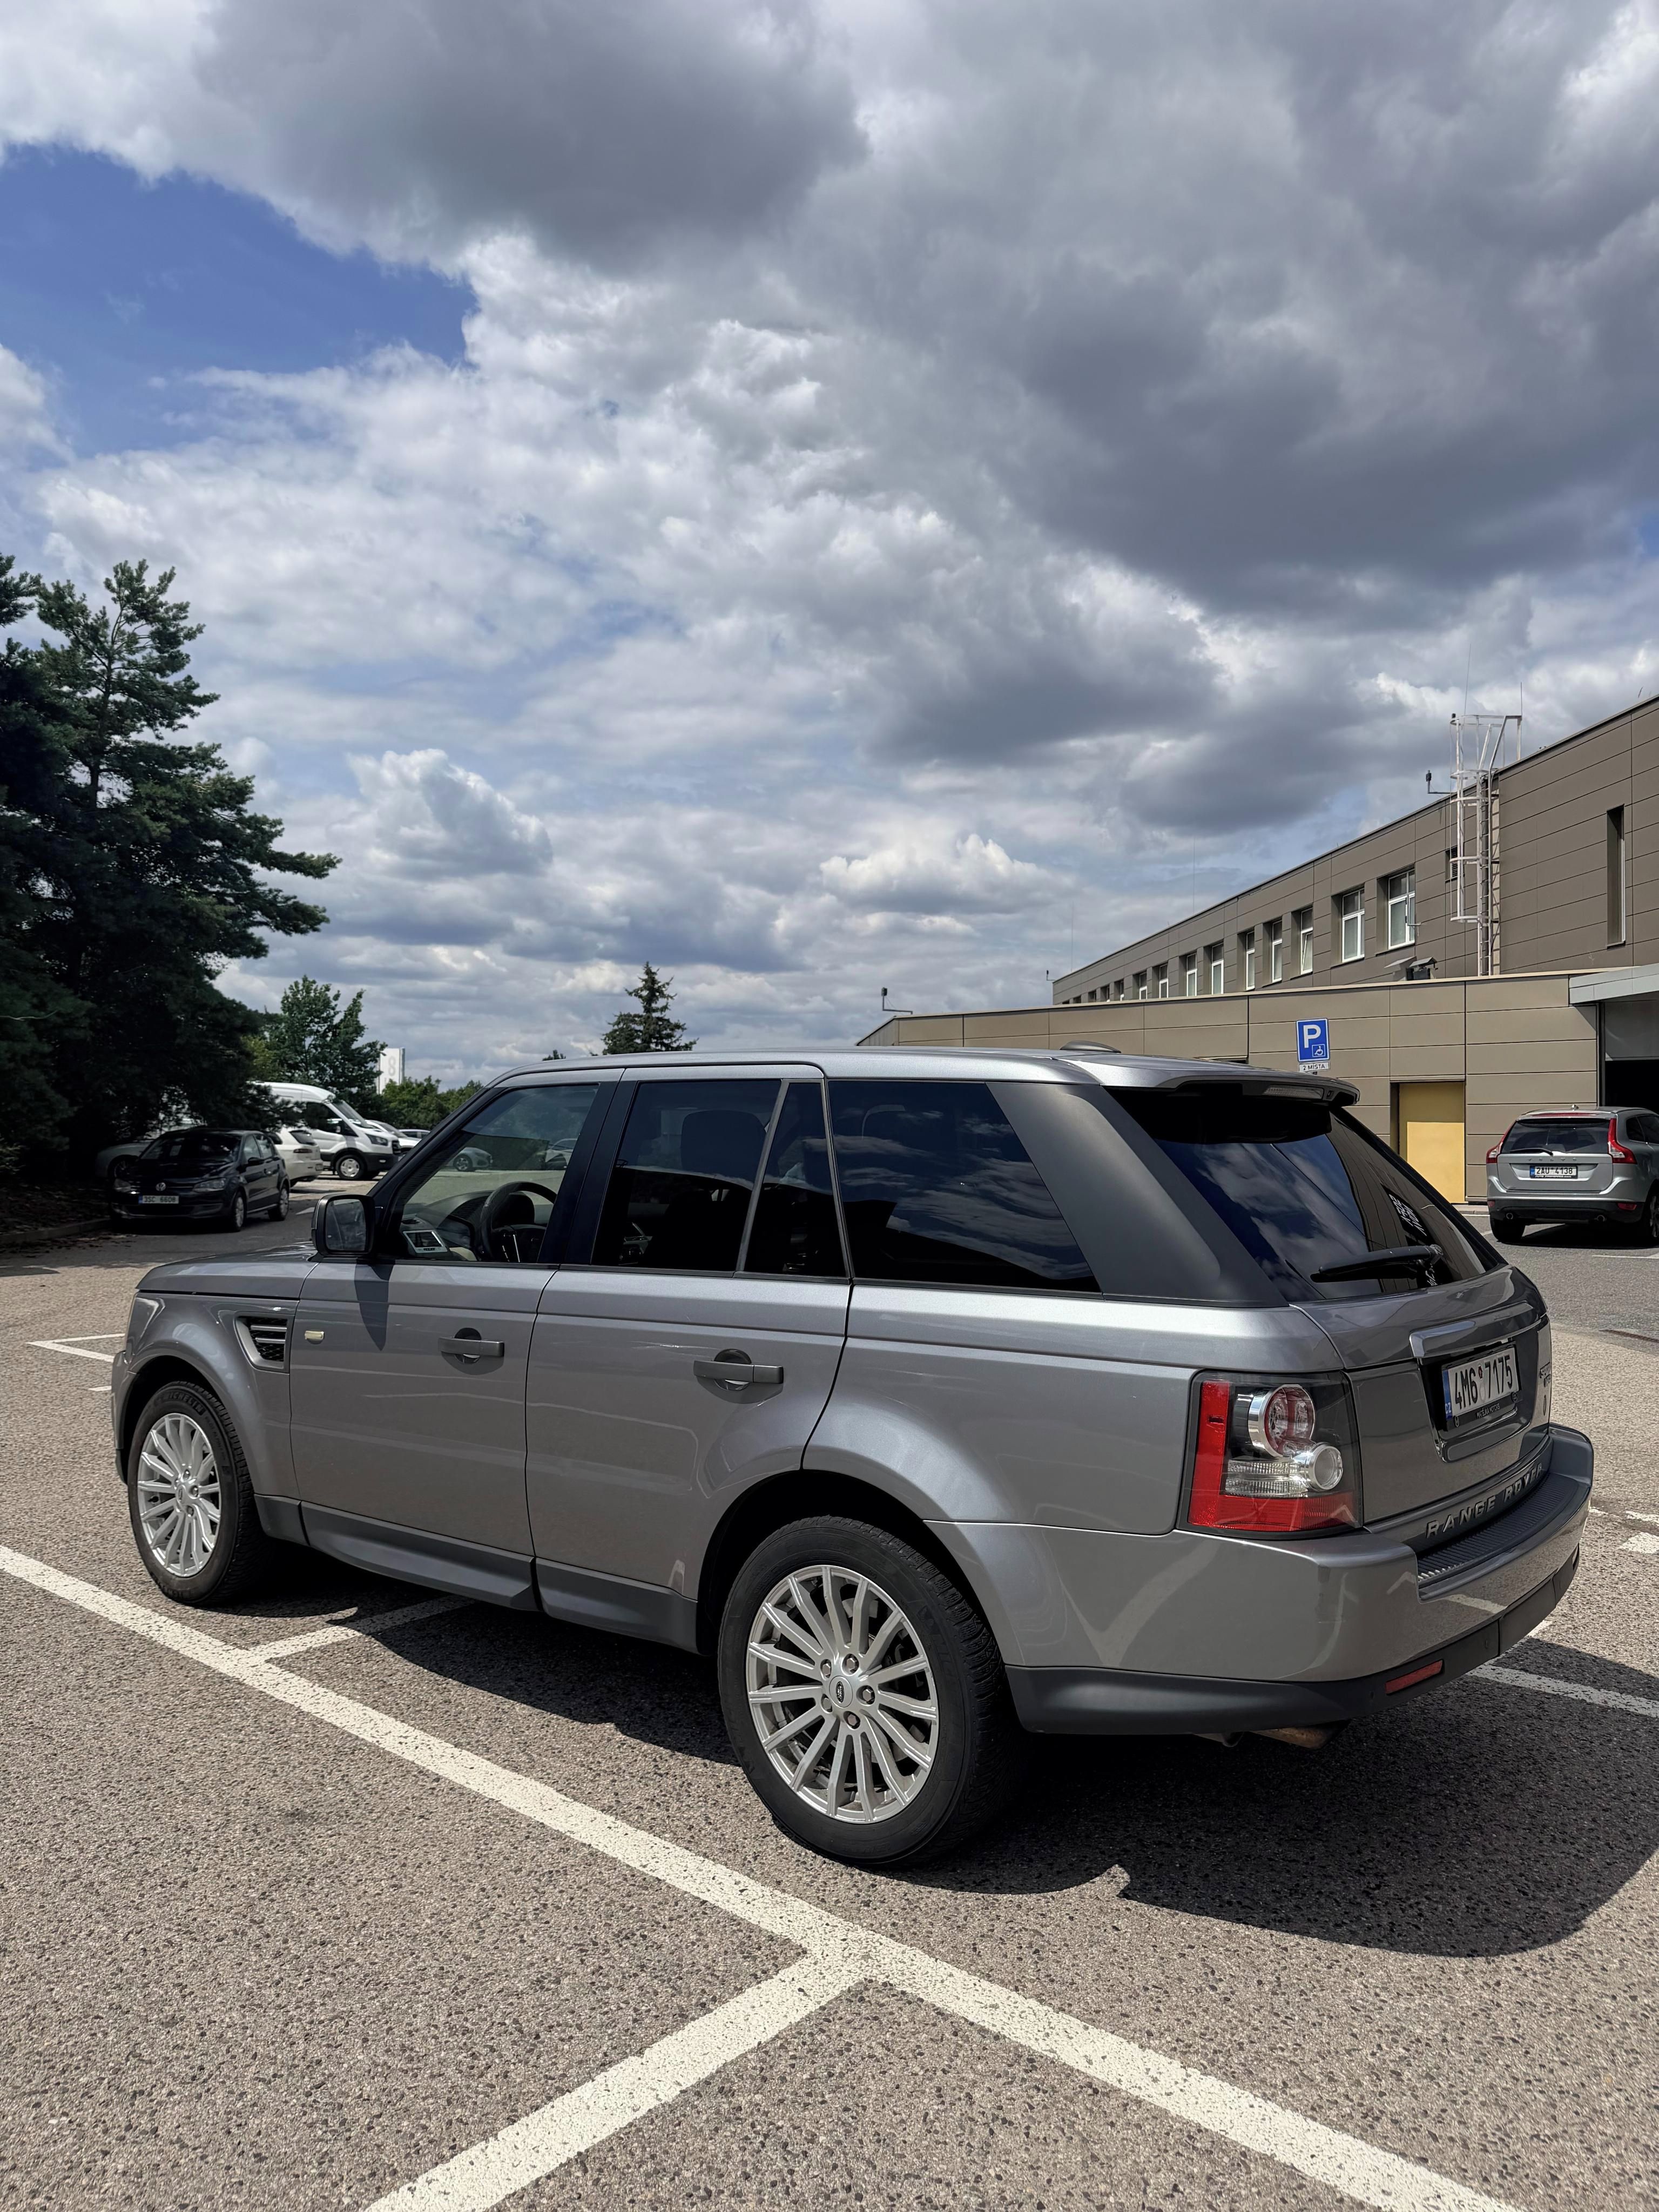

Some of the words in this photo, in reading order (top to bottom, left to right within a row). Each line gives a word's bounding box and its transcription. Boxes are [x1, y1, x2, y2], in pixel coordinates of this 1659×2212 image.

[1303, 1024, 1321, 1048] P
[388, 1055, 396, 1076] 8
[1455, 1367, 1478, 1410] 4M6
[1485, 1354, 1513, 1399] 7175
[1445, 1402, 1452, 1414] CZ
[1426, 1495, 1495, 1538] RANGE
[1503, 1462, 1543, 1502] ROVER
